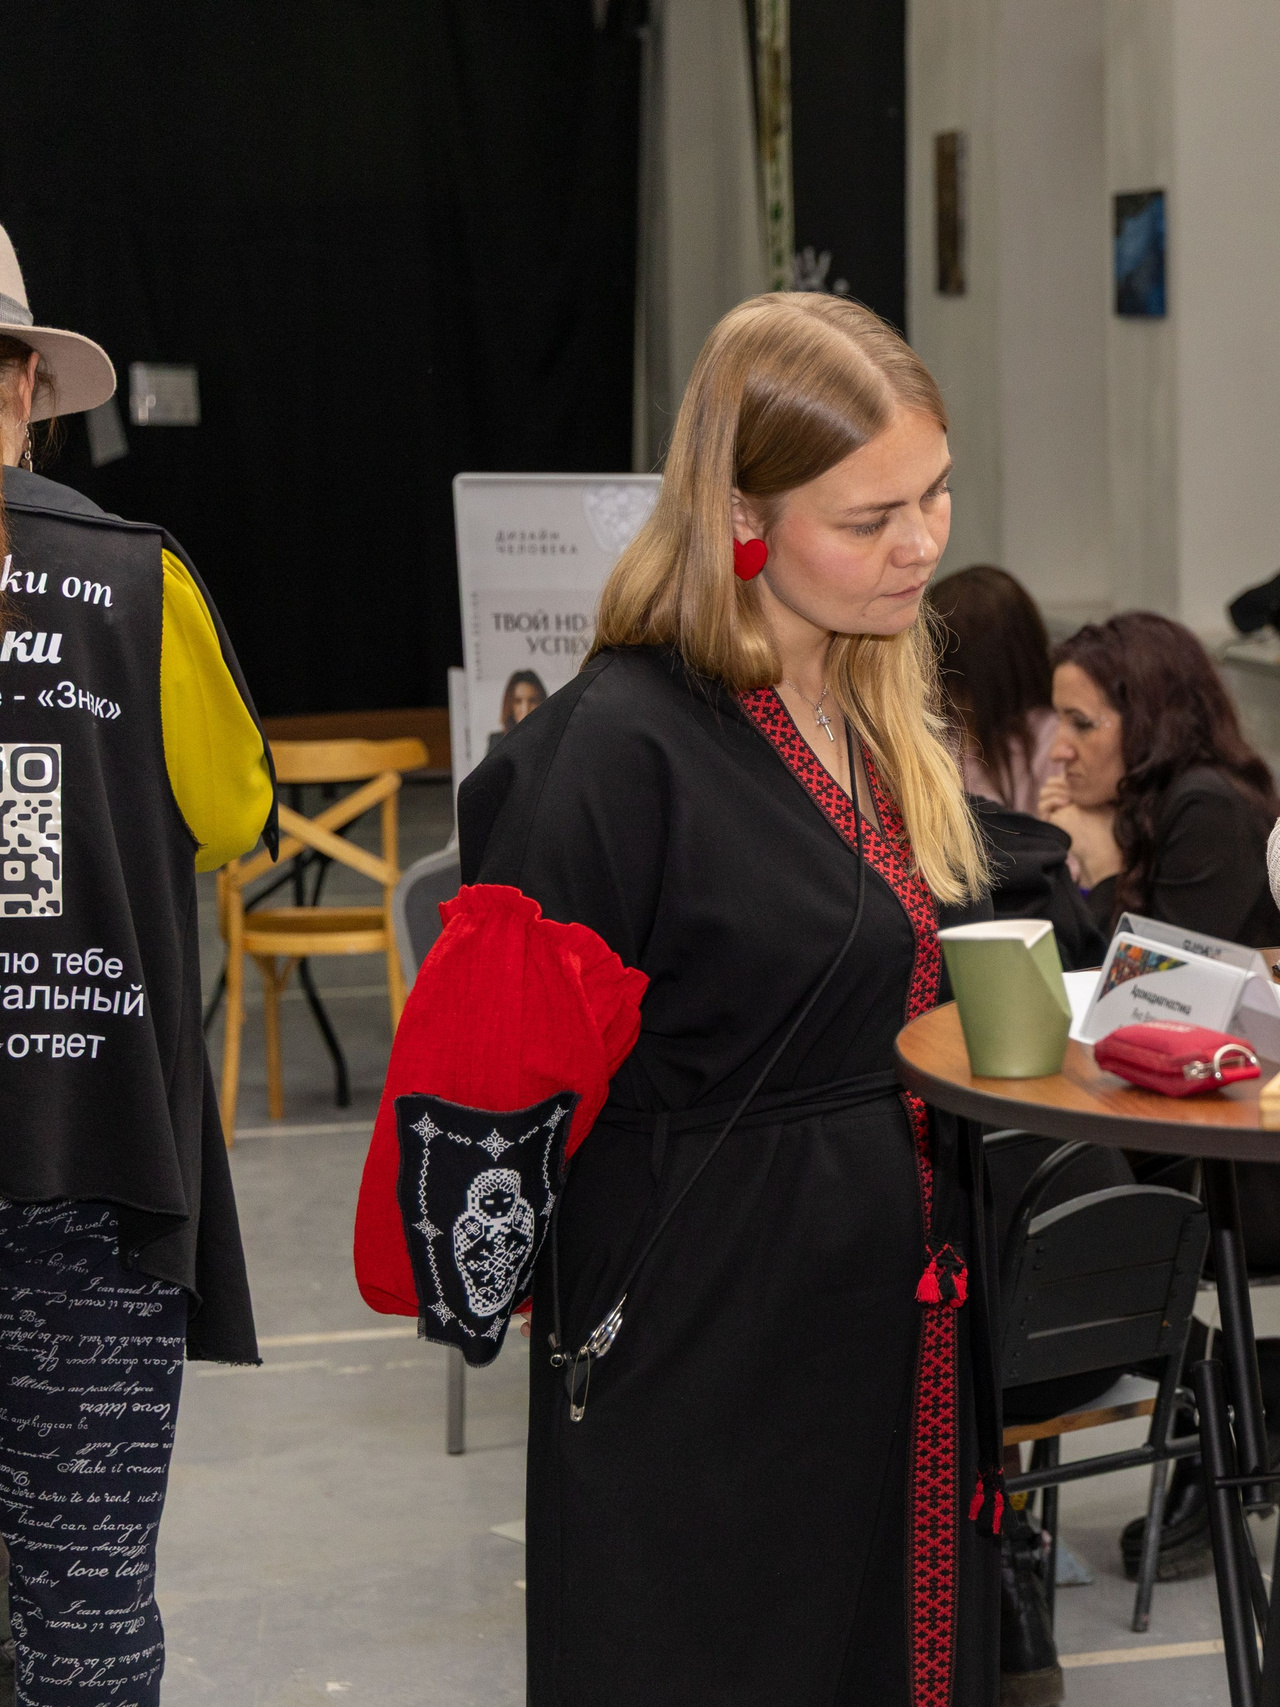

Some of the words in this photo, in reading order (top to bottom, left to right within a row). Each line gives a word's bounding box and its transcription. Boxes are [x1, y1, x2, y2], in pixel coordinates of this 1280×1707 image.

[61, 575, 114, 609] от
[493, 607, 549, 632] ТВОЙ
[52, 947, 124, 979] тебе
[0, 984, 145, 1017] альный
[64, 1211, 109, 1234] travel
[101, 1346, 139, 1374] change
[143, 1358, 168, 1367] can
[79, 1402, 127, 1420] letters
[132, 1402, 171, 1421] love
[57, 1458, 106, 1474] Make
[111, 1462, 124, 1474] it
[18, 1509, 62, 1529] travel
[61, 1521, 87, 1531] can
[93, 1514, 142, 1544] change
[67, 1560, 110, 1578] love
[39, 1666, 84, 1687] your
[79, 1666, 128, 1695] change
